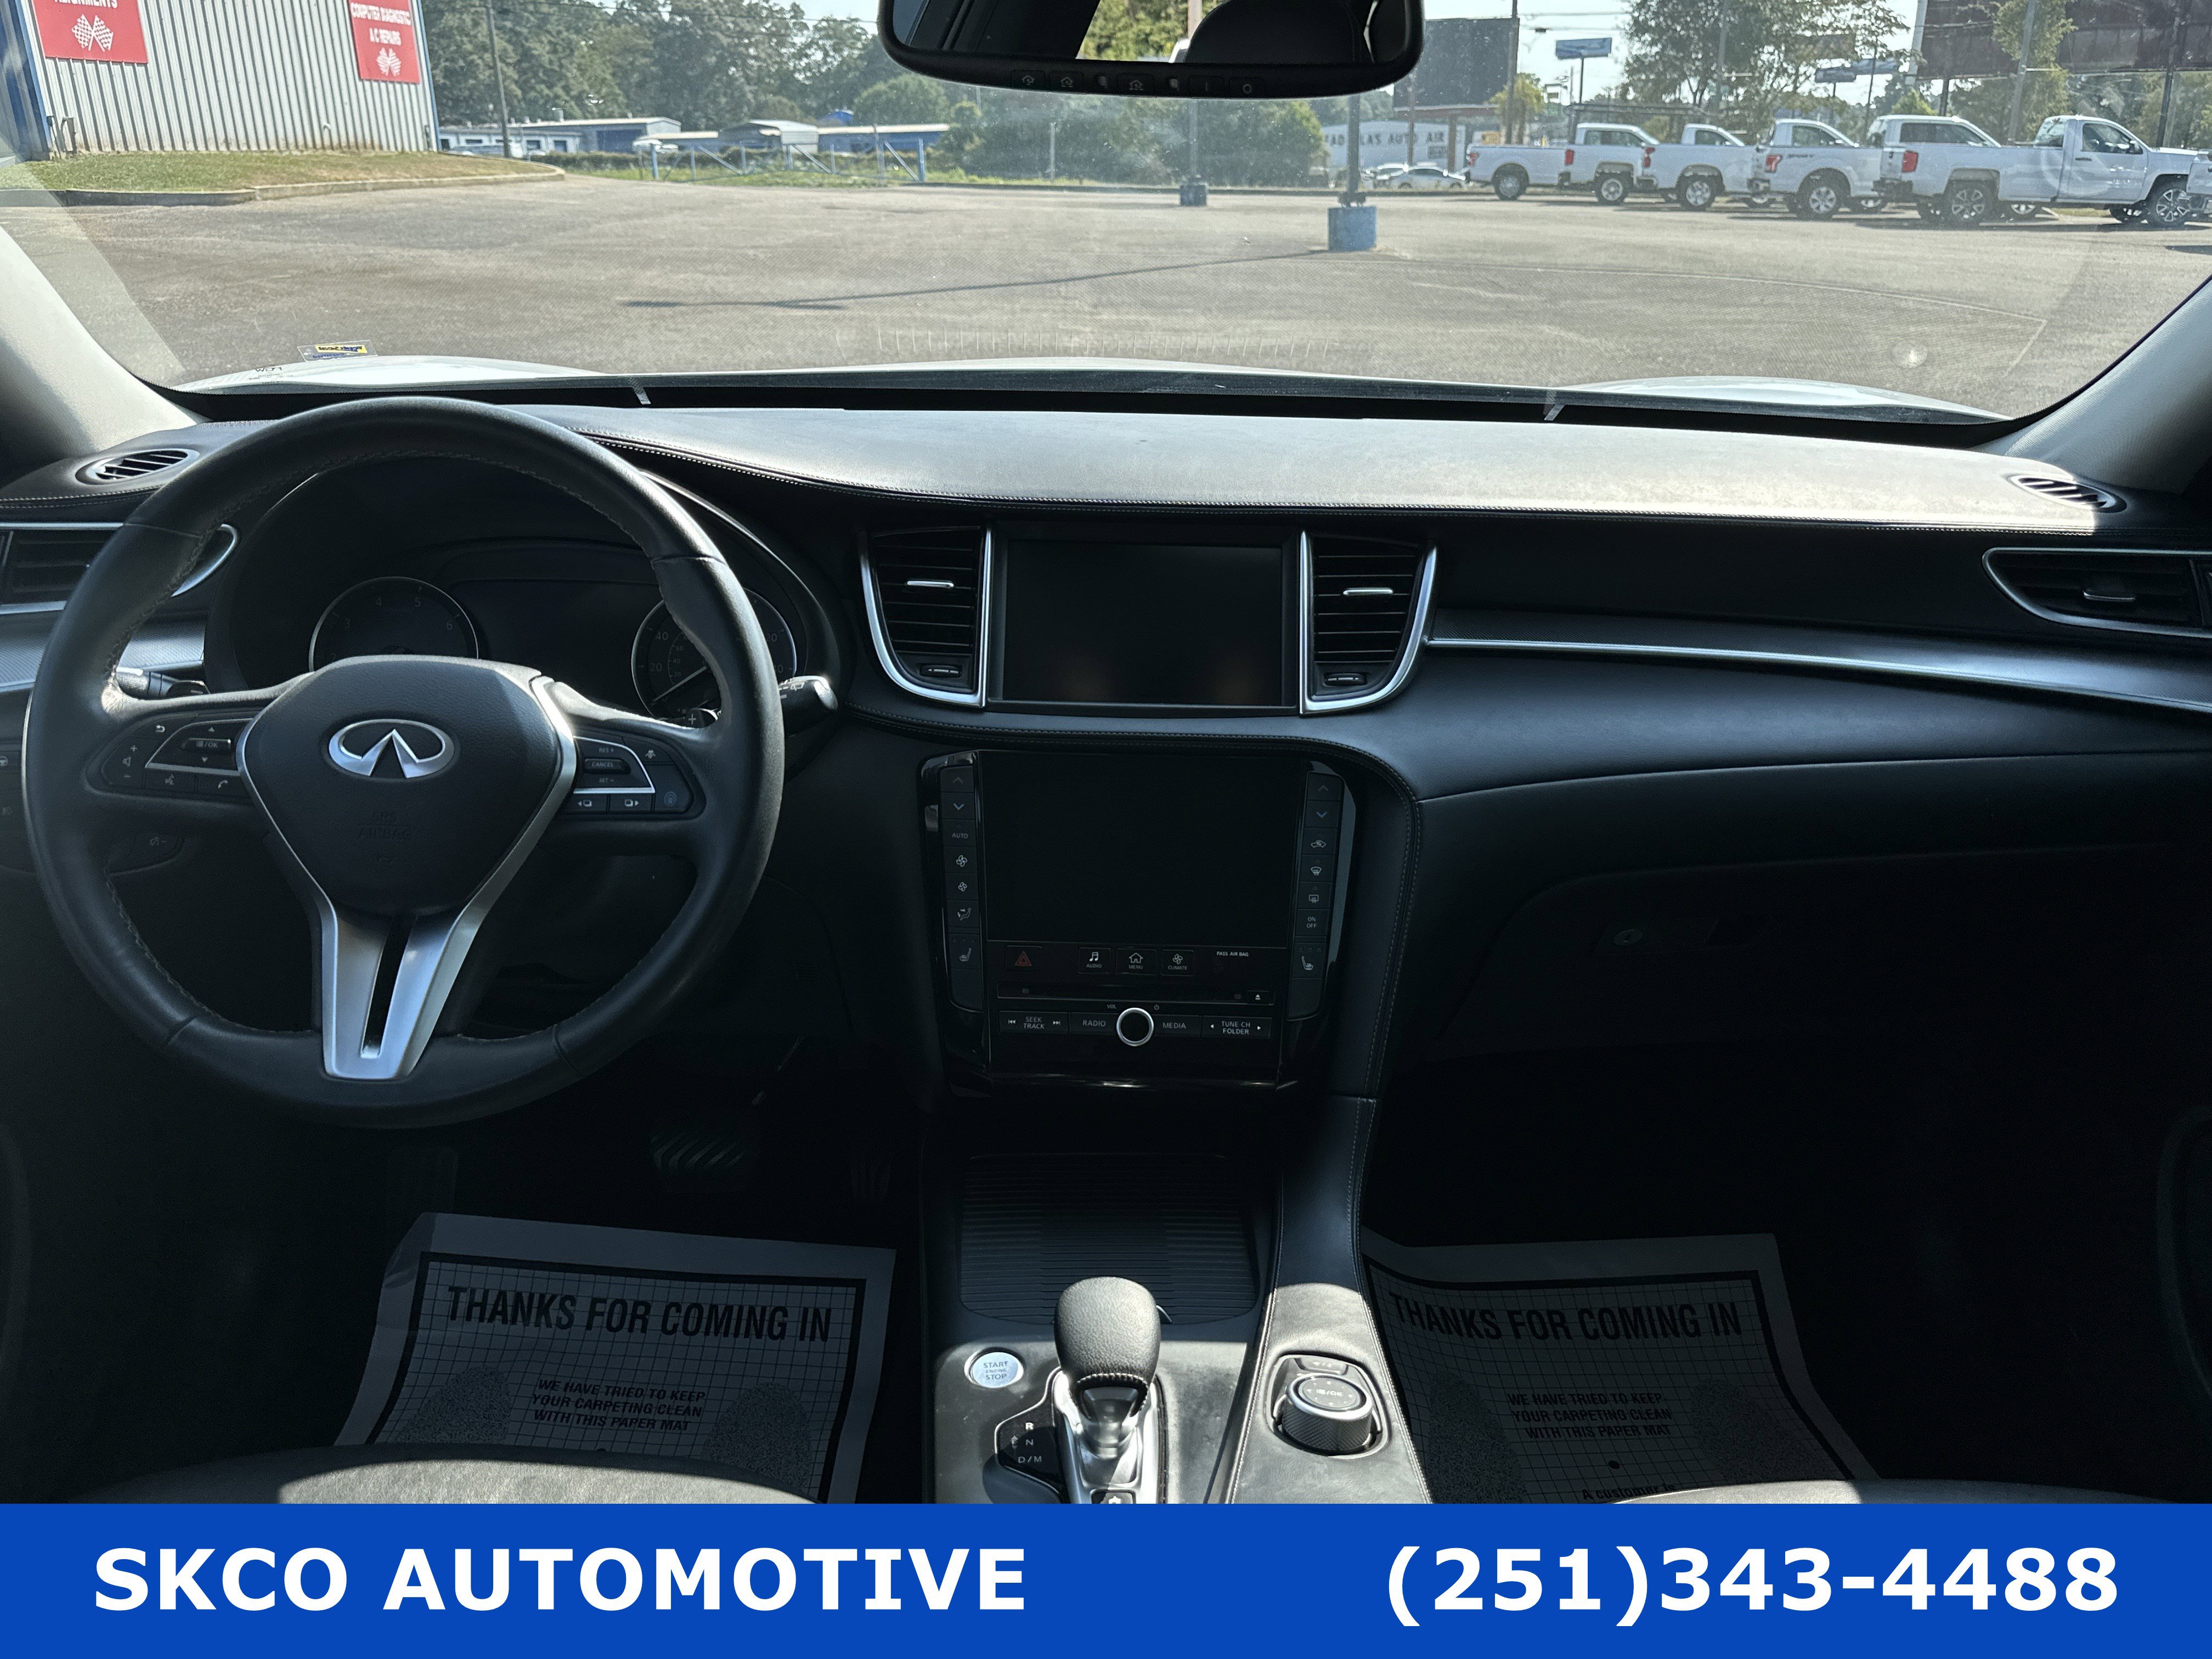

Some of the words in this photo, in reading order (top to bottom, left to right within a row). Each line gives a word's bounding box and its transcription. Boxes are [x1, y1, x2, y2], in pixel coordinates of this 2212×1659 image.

[449, 1286, 577, 1330] THANKS
[585, 1297, 652, 1334] FOR
[661, 1301, 789, 1341] COMING
[799, 1306, 832, 1341] IN
[1389, 1292, 1502, 1340] THANKS
[1508, 1310, 1572, 1340] FOR
[1578, 1304, 1702, 1341] COMING
[1708, 1301, 1743, 1337] IN
[538, 1379, 560, 1391] WE
[564, 1381, 601, 1395] HAVE
[604, 1385, 644, 1398] TRIED
[649, 1388, 666, 1400] TO
[670, 1390, 706, 1402] KEEP
[532, 1393, 571, 1407] YOUR
[574, 1397, 653, 1414] CARPETING
[657, 1404, 703, 1417] CLEAN
[1508, 1392, 1530, 1406] WE
[1532, 1392, 1566, 1405] HAVE
[1570, 1392, 1607, 1404] TRIED
[1612, 1392, 1628, 1404] TO
[1632, 1392, 1662, 1404] KEEP
[534, 1409, 571, 1424] WITH
[575, 1413, 607, 1427] THIS
[611, 1417, 656, 1429] PAPER
[660, 1419, 691, 1431] MAT
[1511, 1410, 1551, 1423] YOUR
[1553, 1409, 1628, 1422] CARPETING
[1630, 1408, 1672, 1421] CLEAN
[1025, 1422, 1035, 1430] R
[1525, 1427, 1562, 1439] WITH
[1565, 1426, 1595, 1438] THIS
[1599, 1425, 1641, 1437] PAPER
[1646, 1424, 1672, 1436] MAT
[1018, 1455, 1042, 1464] D/M
[1582, 1488, 1594, 1500] A
[1595, 1485, 1659, 1499] customer
